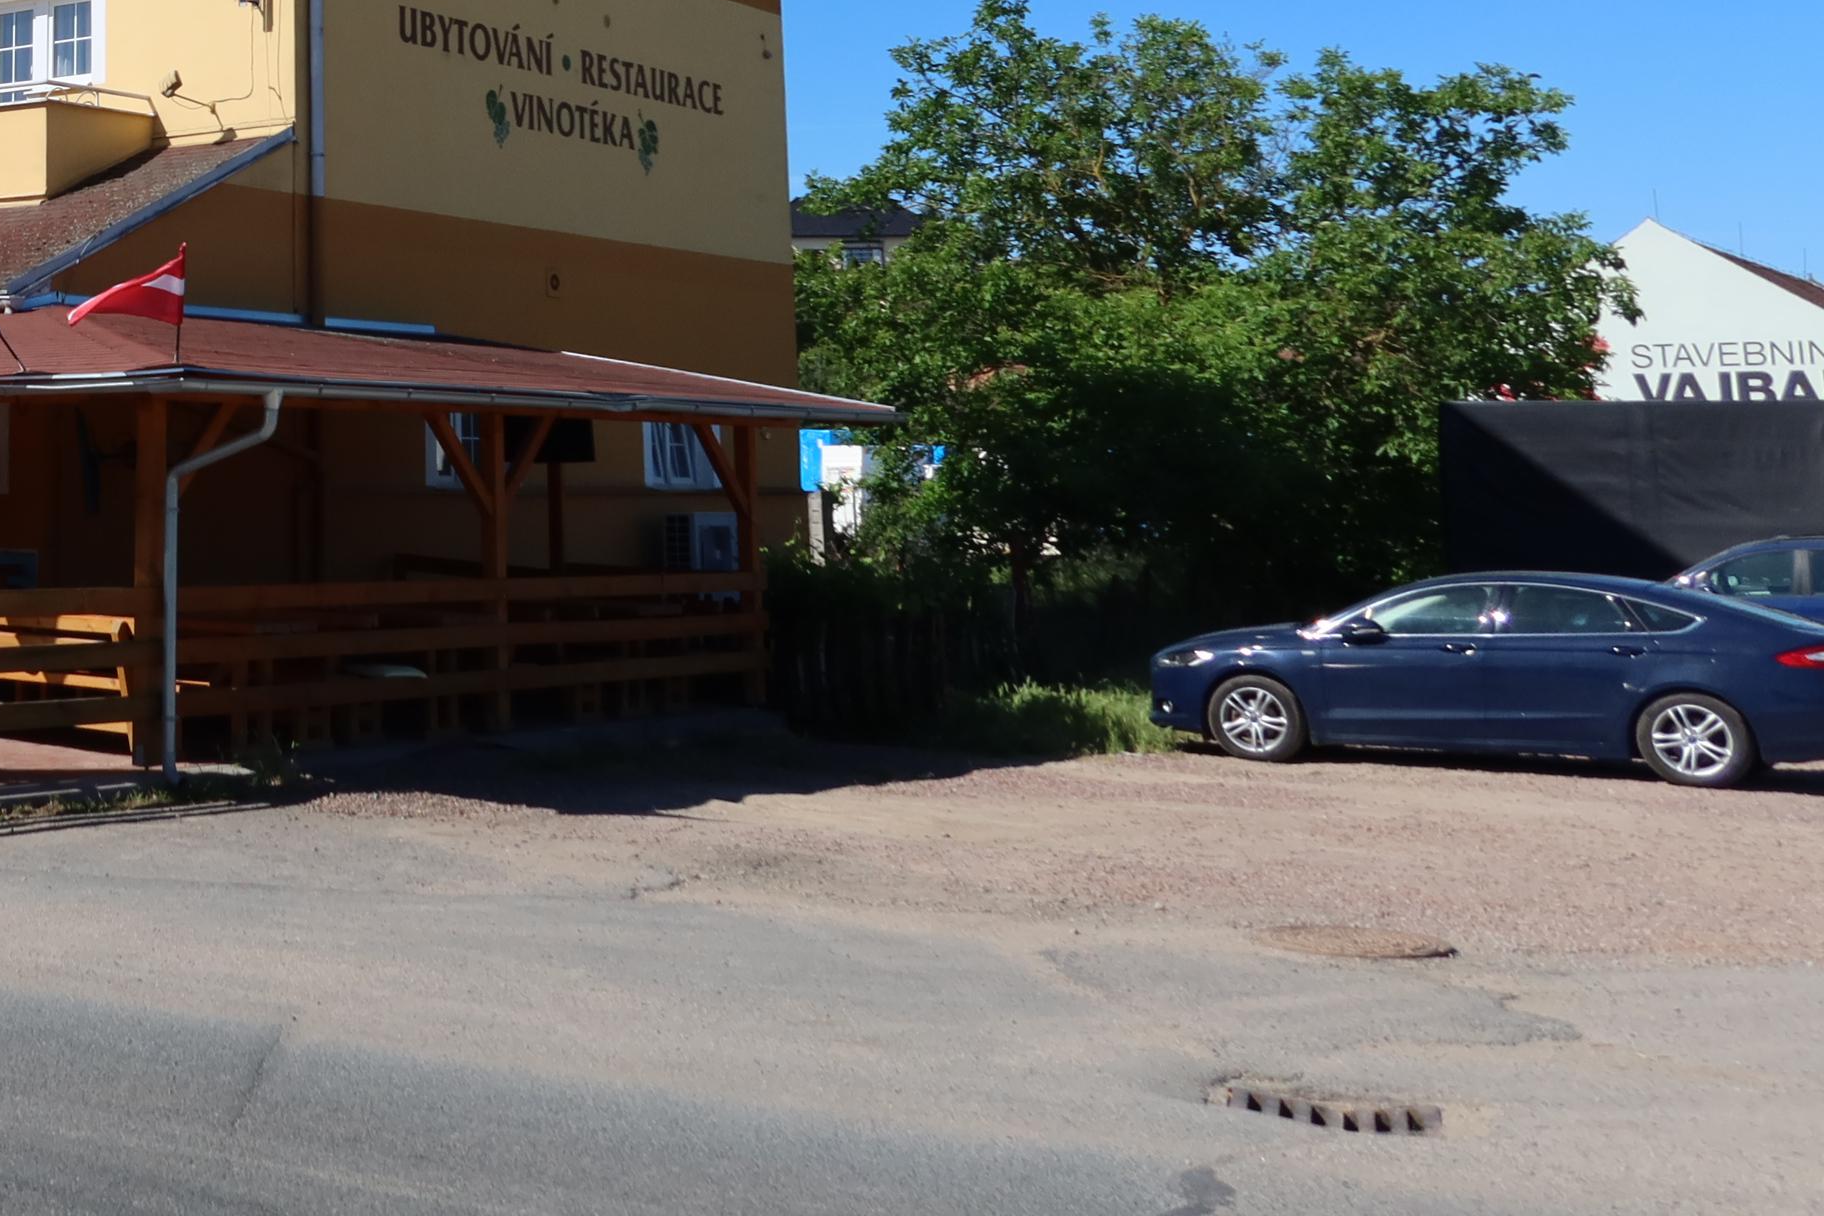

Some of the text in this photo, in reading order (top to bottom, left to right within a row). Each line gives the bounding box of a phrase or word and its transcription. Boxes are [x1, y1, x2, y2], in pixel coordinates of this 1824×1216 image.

[398, 4, 725, 116] UBYTOVÁNÍ RESTAURACE
[510, 90, 636, 150] VINOTÉKA
